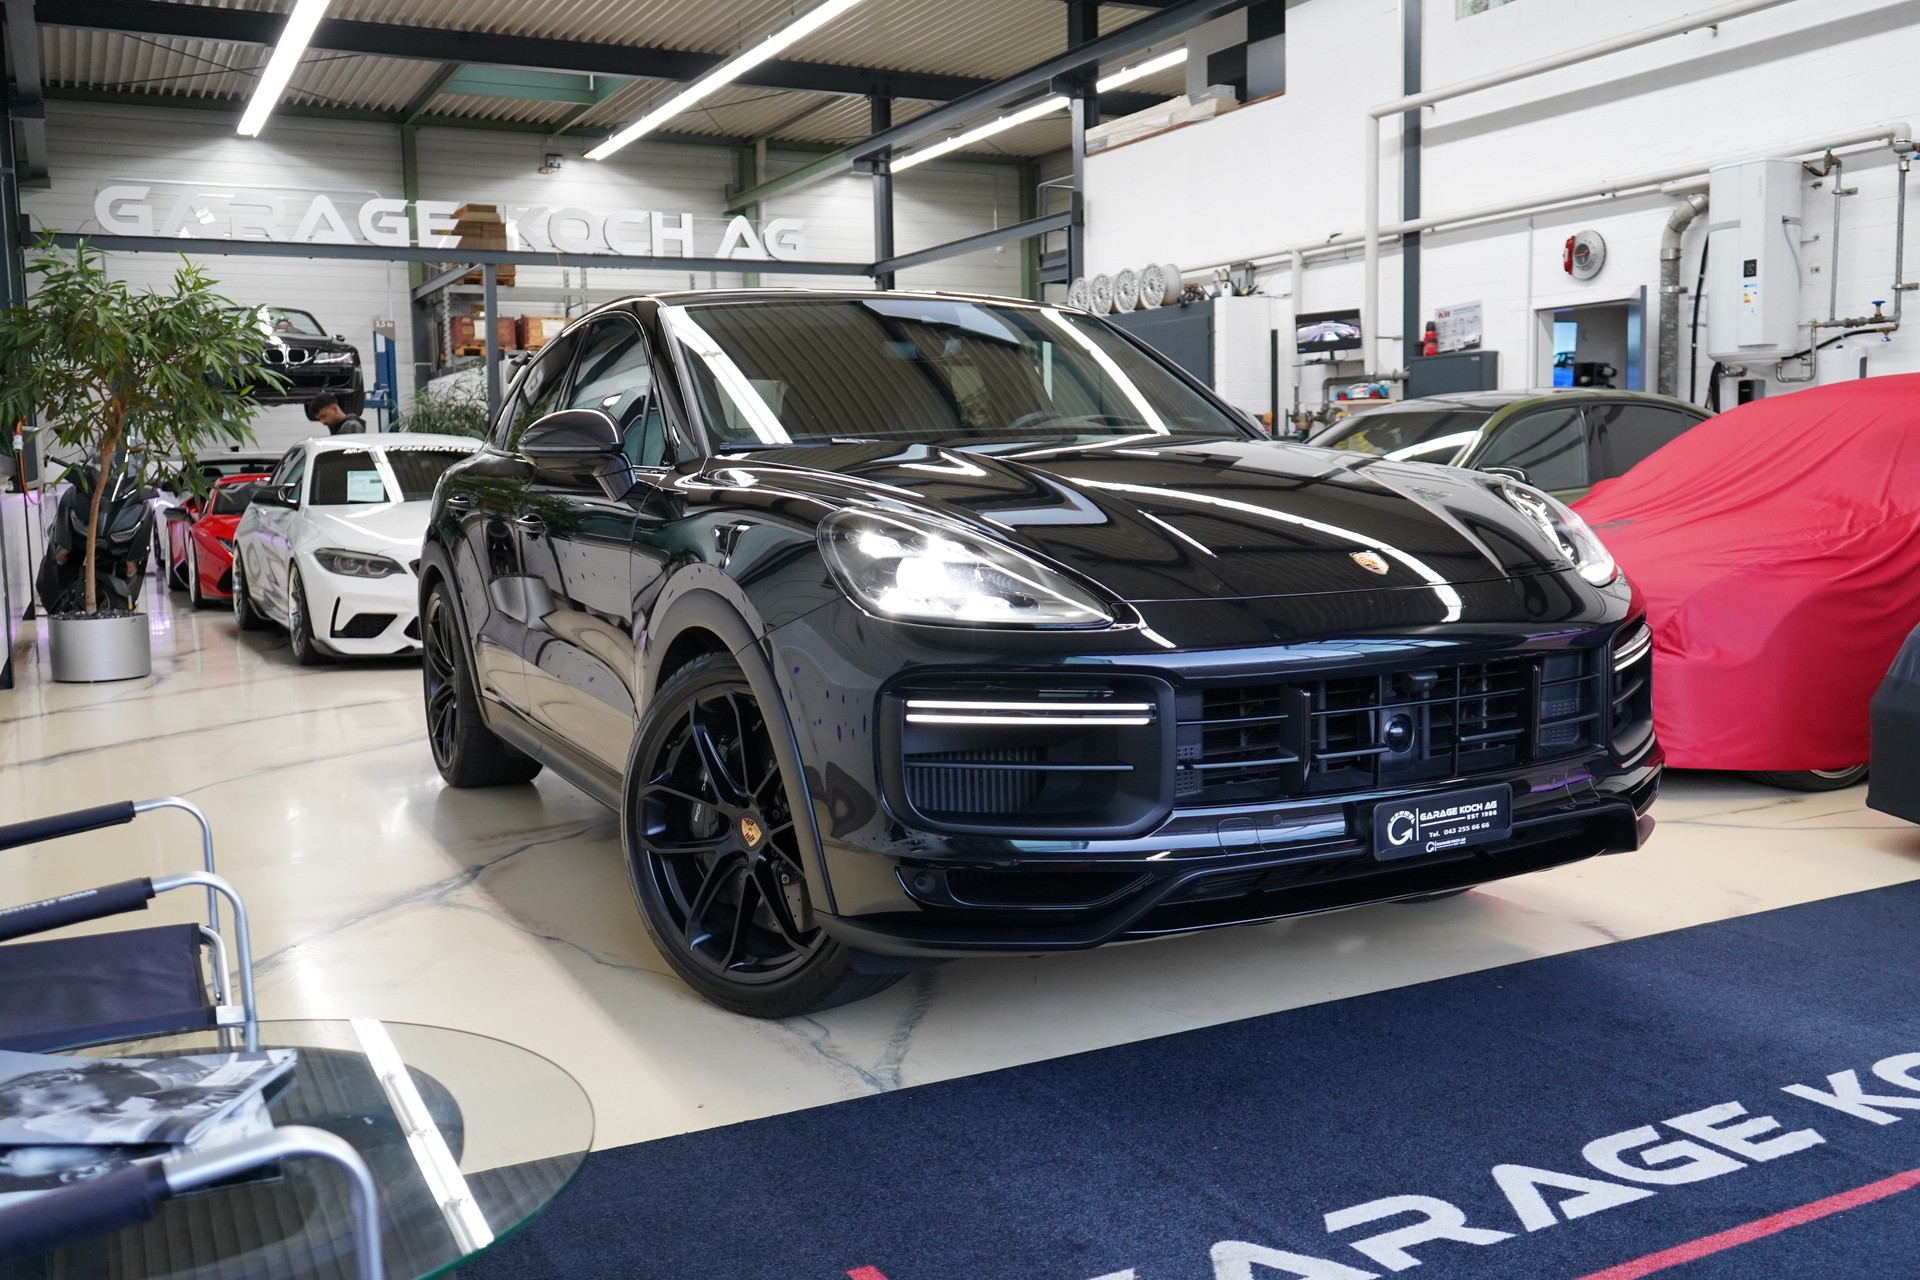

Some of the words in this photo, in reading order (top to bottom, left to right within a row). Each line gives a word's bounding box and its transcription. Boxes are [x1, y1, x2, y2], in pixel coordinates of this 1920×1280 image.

[94, 185, 464, 249] GARAGE
[504, 205, 694, 258] KOCH
[715, 214, 808, 262] AG
[1420, 807, 1458, 821] GARAGE
[1459, 803, 1483, 814] KOCH
[1484, 800, 1497, 810] AG
[1443, 827, 1456, 835] 043
[1457, 825, 1471, 833] 255
[1471, 823, 1480, 831] 66
[1481, 821, 1490, 829] 66
[1090, 1100, 1827, 1280] ARAGE
